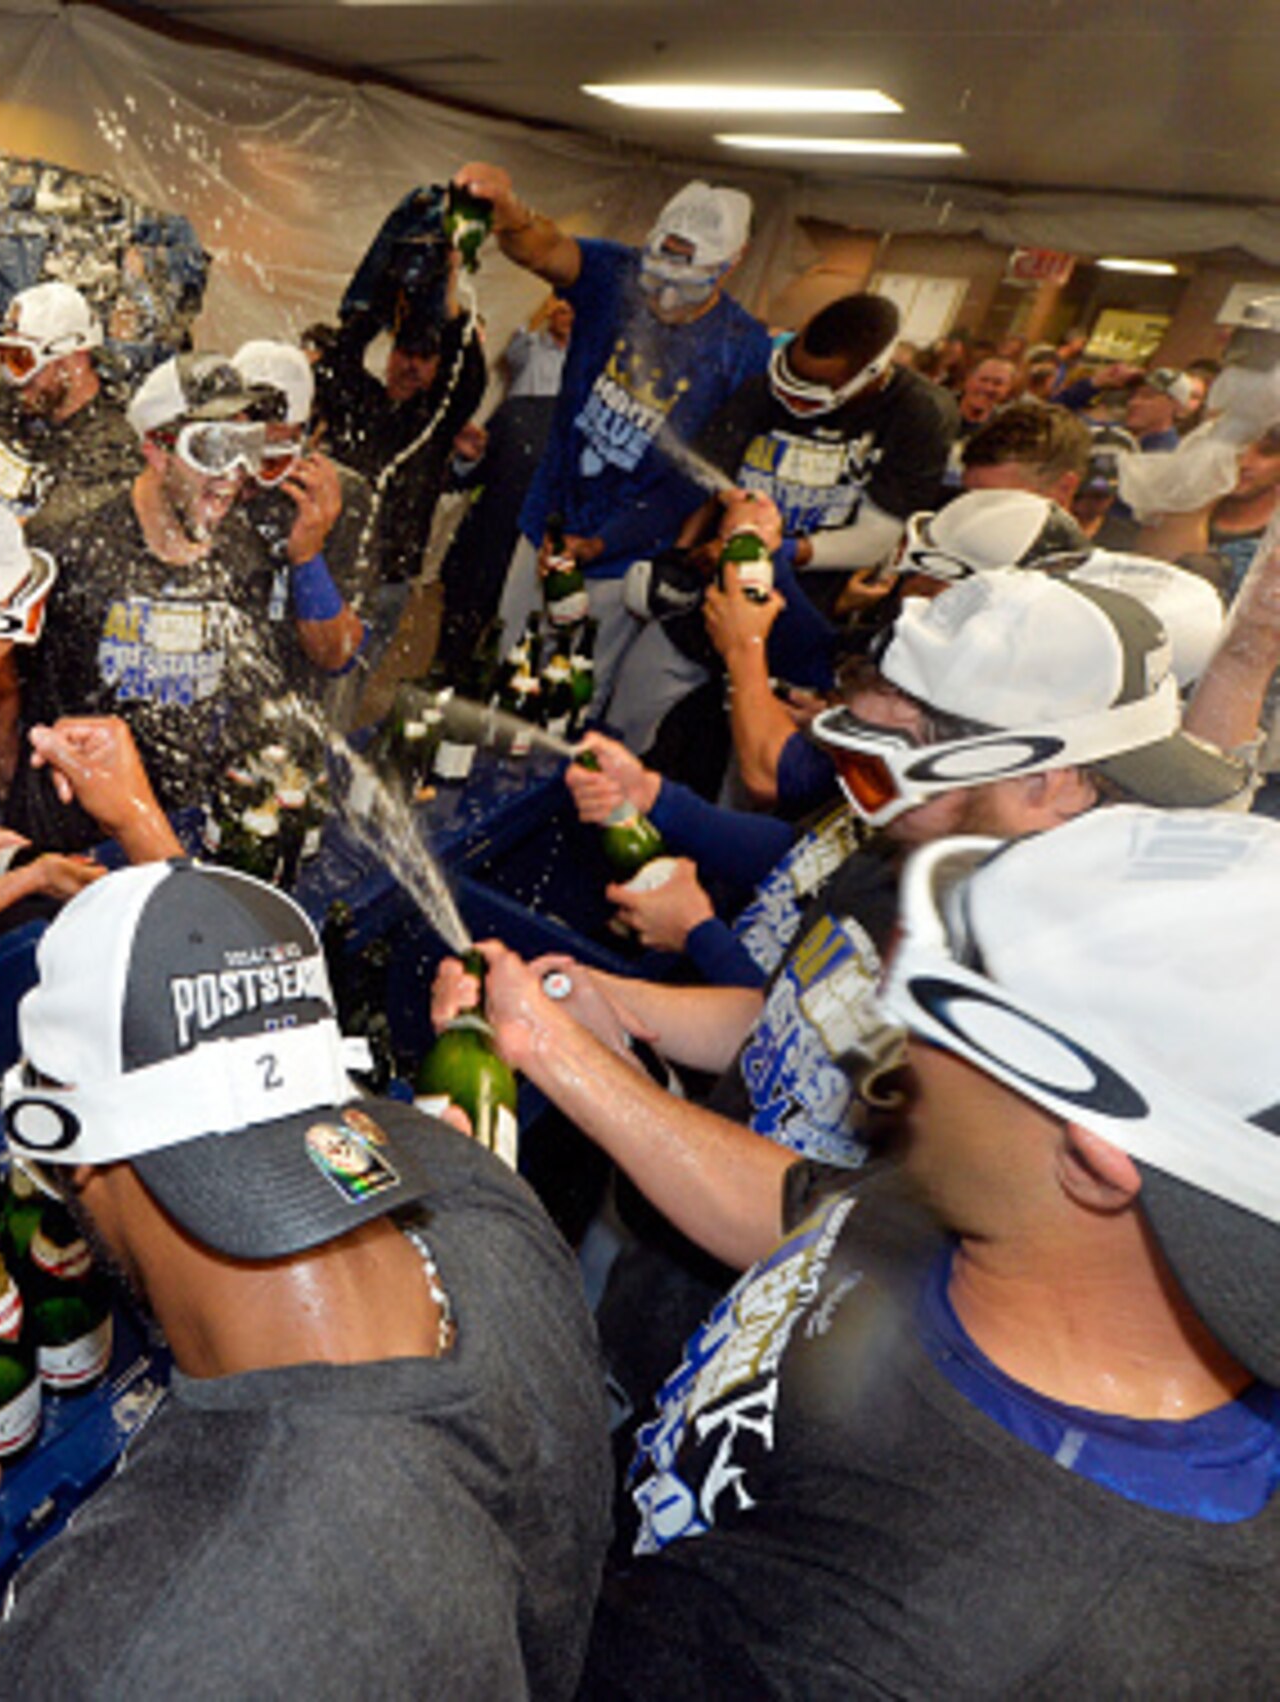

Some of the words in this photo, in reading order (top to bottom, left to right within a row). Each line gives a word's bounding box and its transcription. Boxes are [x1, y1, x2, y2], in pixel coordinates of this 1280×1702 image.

[792, 913, 848, 989] AL
[254, 1053, 285, 1091] 2
[694, 1376, 778, 1526] KC
